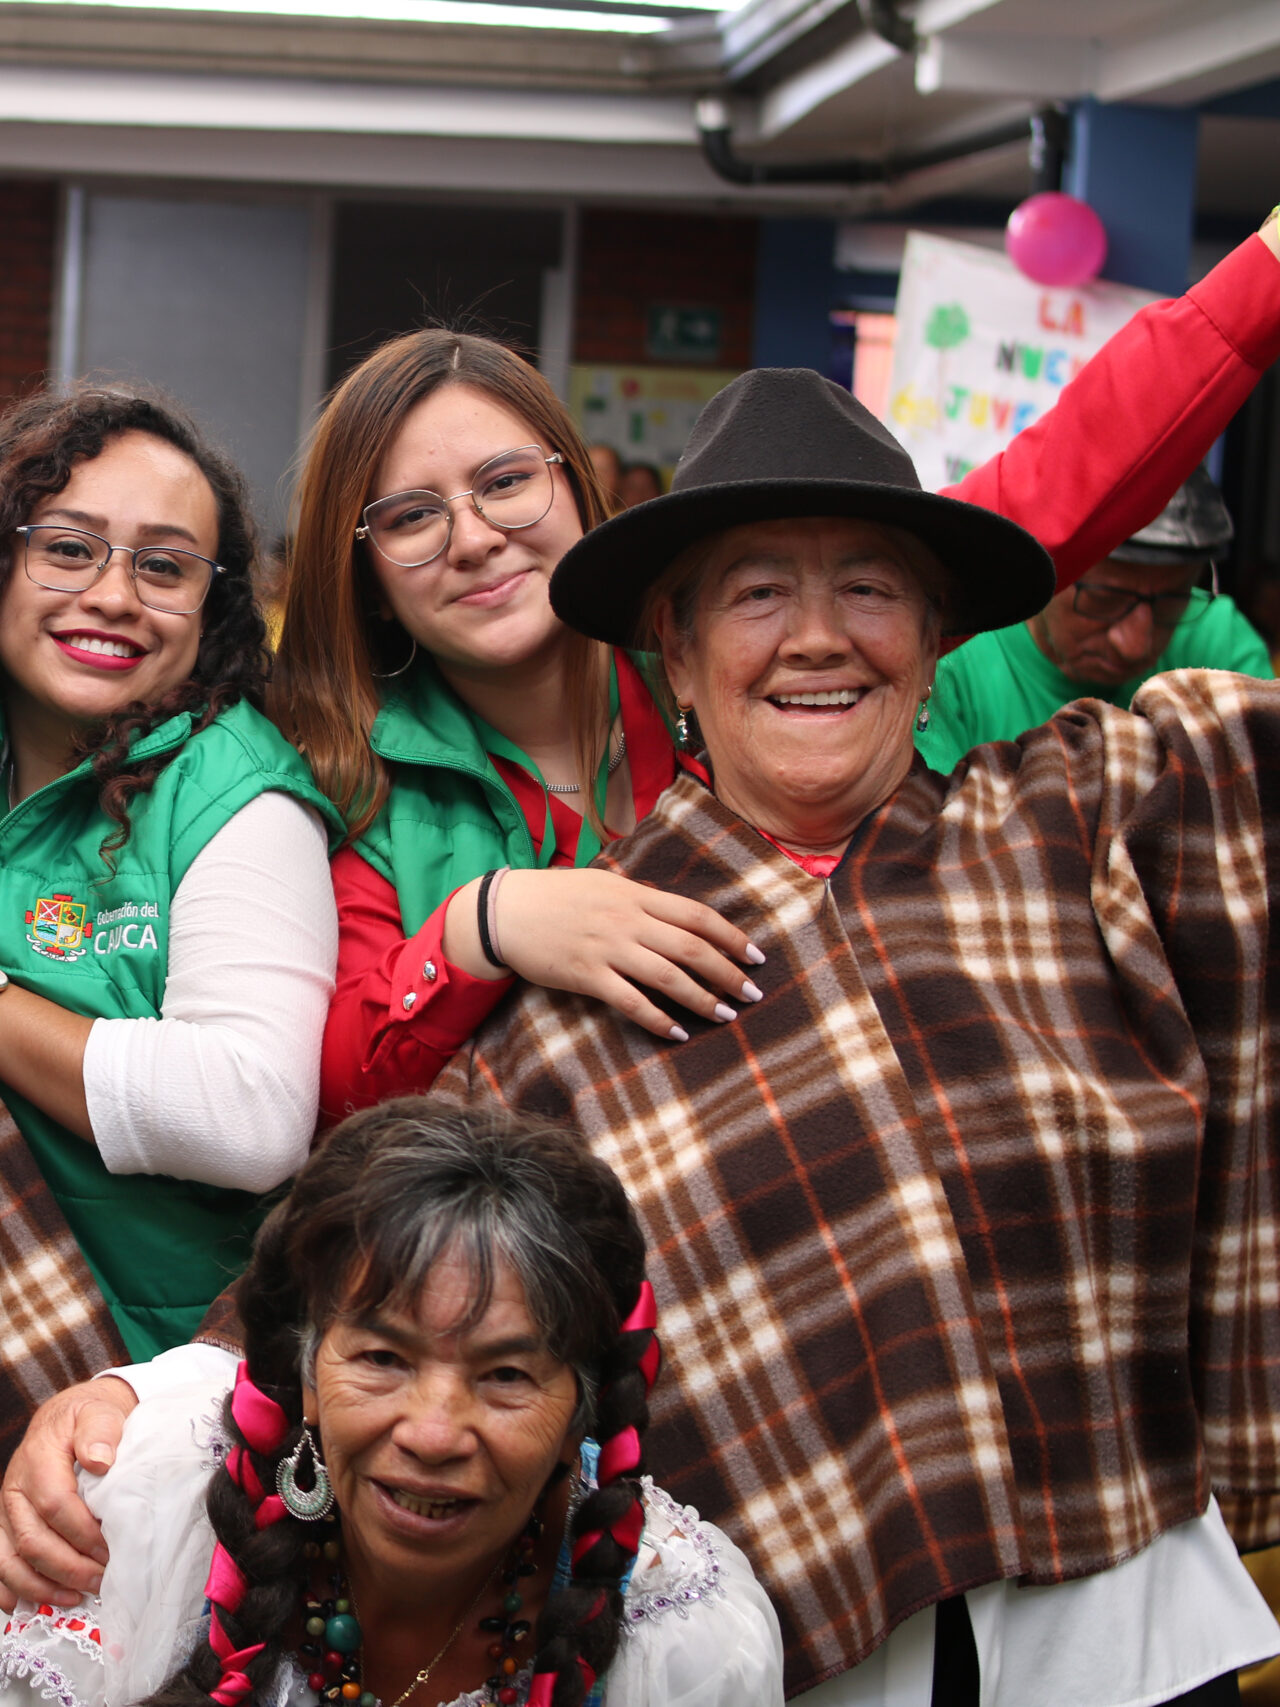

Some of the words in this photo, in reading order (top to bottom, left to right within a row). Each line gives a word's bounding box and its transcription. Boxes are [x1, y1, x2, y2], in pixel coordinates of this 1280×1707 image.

[1038, 297, 1085, 338] LA
[140, 901, 160, 918] del
[94, 923, 158, 954] CAUCA
